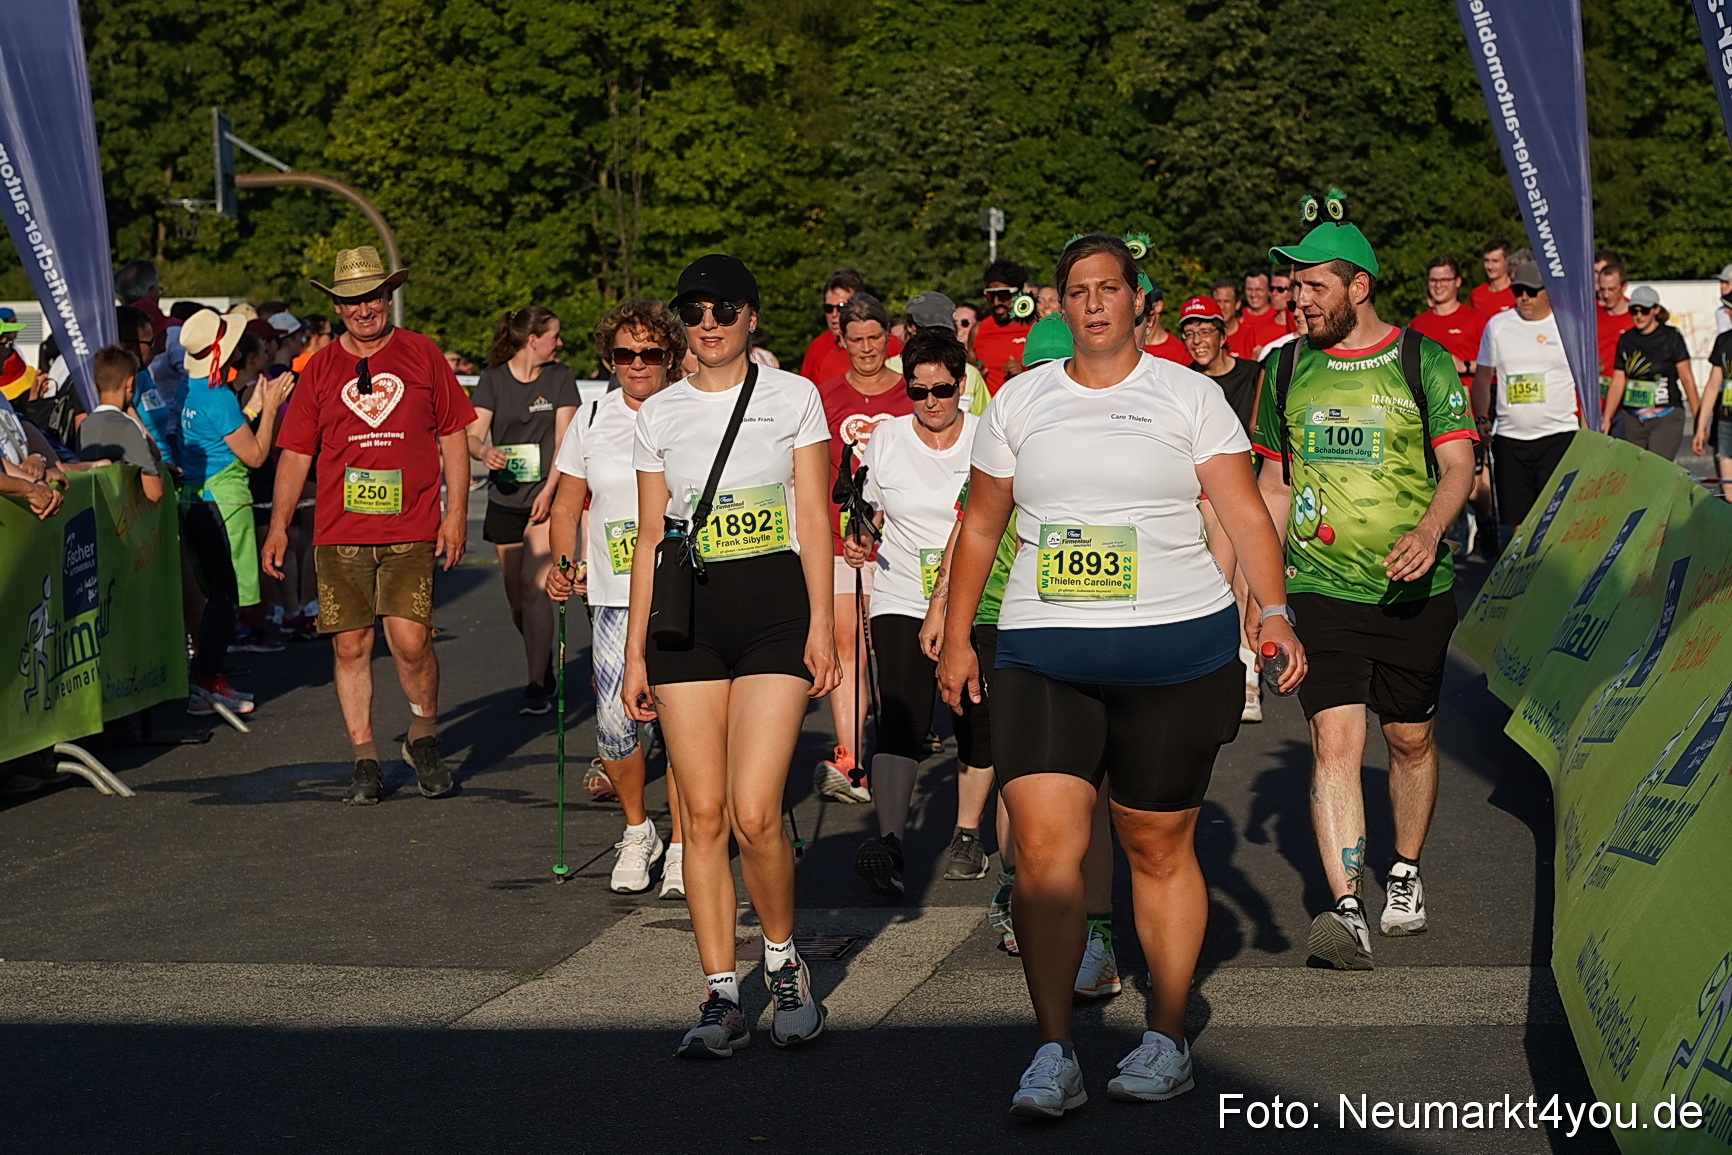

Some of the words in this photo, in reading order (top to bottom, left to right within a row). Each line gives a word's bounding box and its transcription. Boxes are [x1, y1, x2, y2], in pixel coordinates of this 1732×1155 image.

[1513, 383, 1539, 395] 1354
[1128, 414, 1153, 423] Thielen
[348, 432, 405, 442] Steuerberatung
[1308, 431, 1316, 453] RUN
[1324, 426, 1364, 447] 100
[1372, 431, 1381, 459] 2022
[1314, 446, 1354, 455] Schabdach
[1355, 446, 1372, 457] Jörg
[357, 485, 387, 500] 250
[710, 509, 773, 538] 1892
[774, 510, 784, 541] 2022
[701, 528, 710, 553] WAL
[716, 538, 741, 548] Frank
[742, 534, 771, 544] Sibylle
[66, 541, 95, 568] Fischer
[611, 542, 621, 568] WALK
[1053, 550, 1120, 576] 1893
[924, 568, 933, 594] WALK
[1041, 553, 1050, 589] WALK
[1049, 576, 1081, 586] Thielen
[1083, 577, 1122, 587] Caroline
[1123, 556, 1132, 590] 2022
